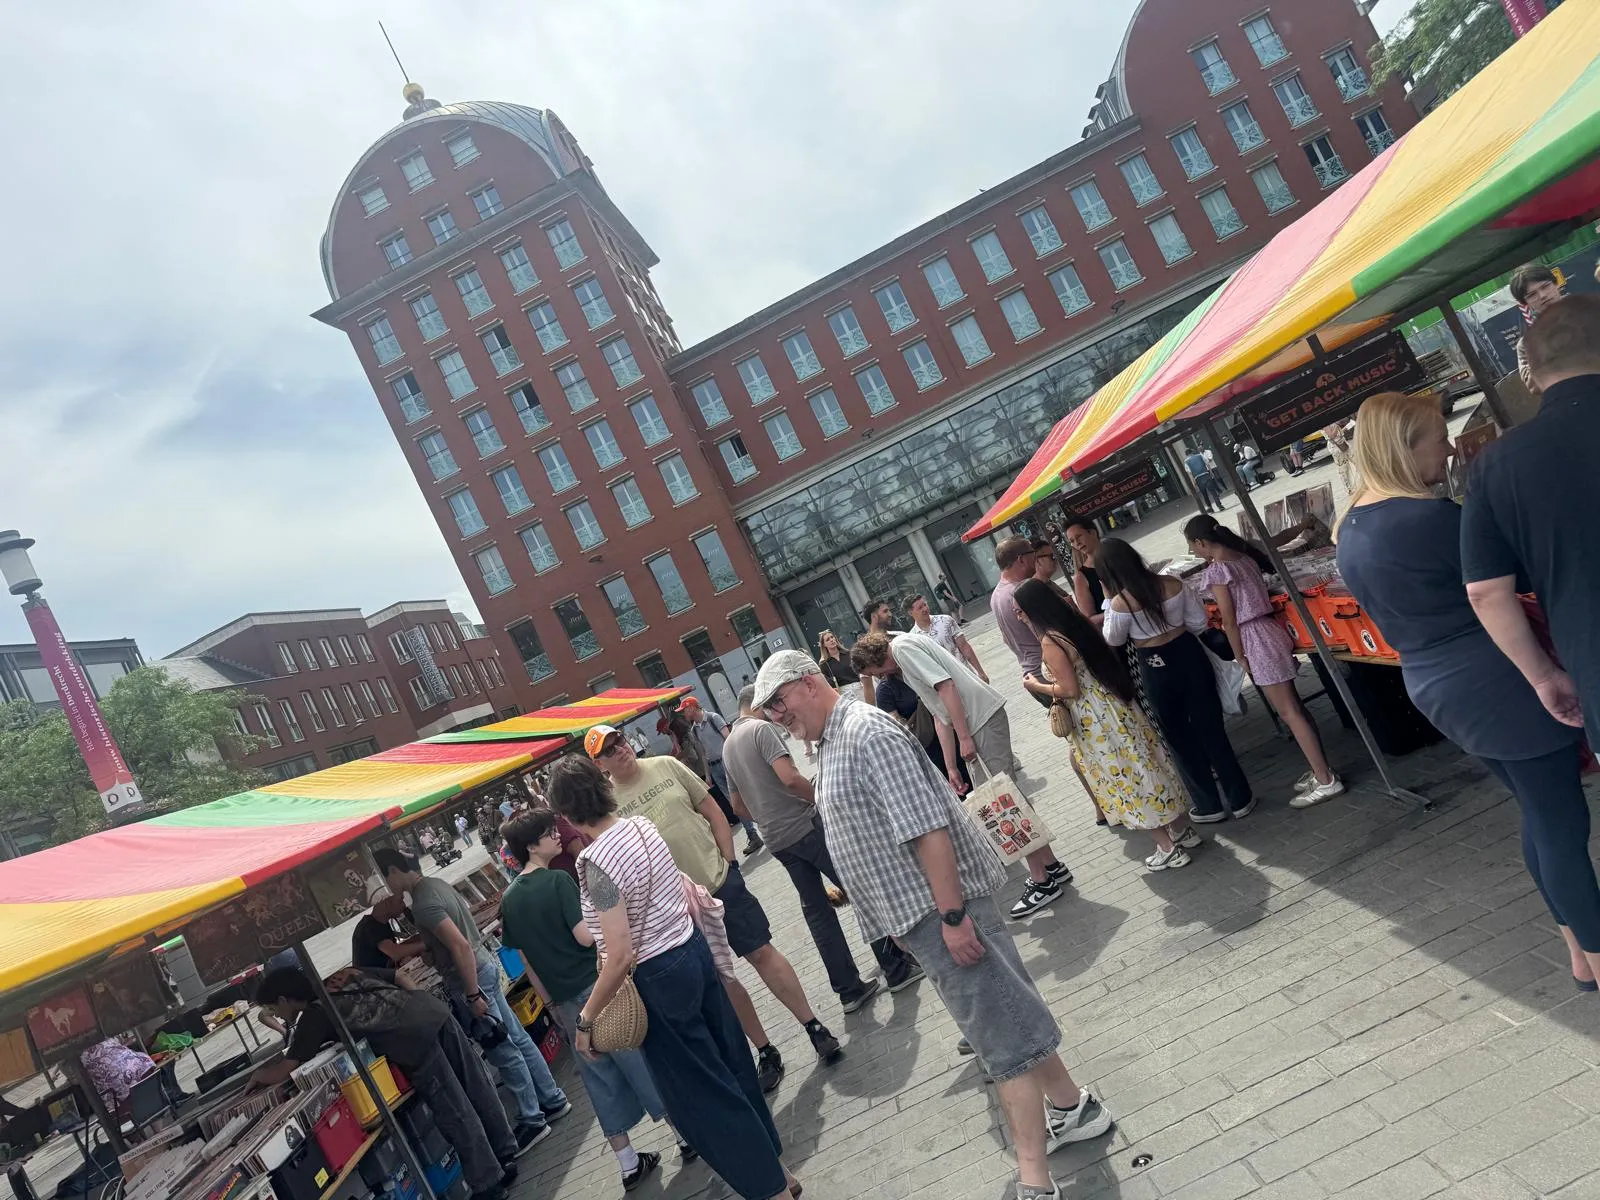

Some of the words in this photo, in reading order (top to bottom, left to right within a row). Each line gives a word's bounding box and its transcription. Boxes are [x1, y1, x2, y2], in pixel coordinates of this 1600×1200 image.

[1268, 405, 1299, 428] GET
[1302, 384, 1345, 413] BACK
[1347, 358, 1397, 391] MUSIC
[1094, 490, 1119, 507] BACK
[1120, 474, 1149, 493] MUSIC
[54, 632, 84, 690] ontdekking
[53, 665, 75, 706] Dordrecht
[74, 712, 90, 738] begint
[82, 688, 111, 748] historische
[617, 801, 640, 818] PME
[639, 778, 675, 805] LEGEND
[258, 910, 328, 950] QUEEN
